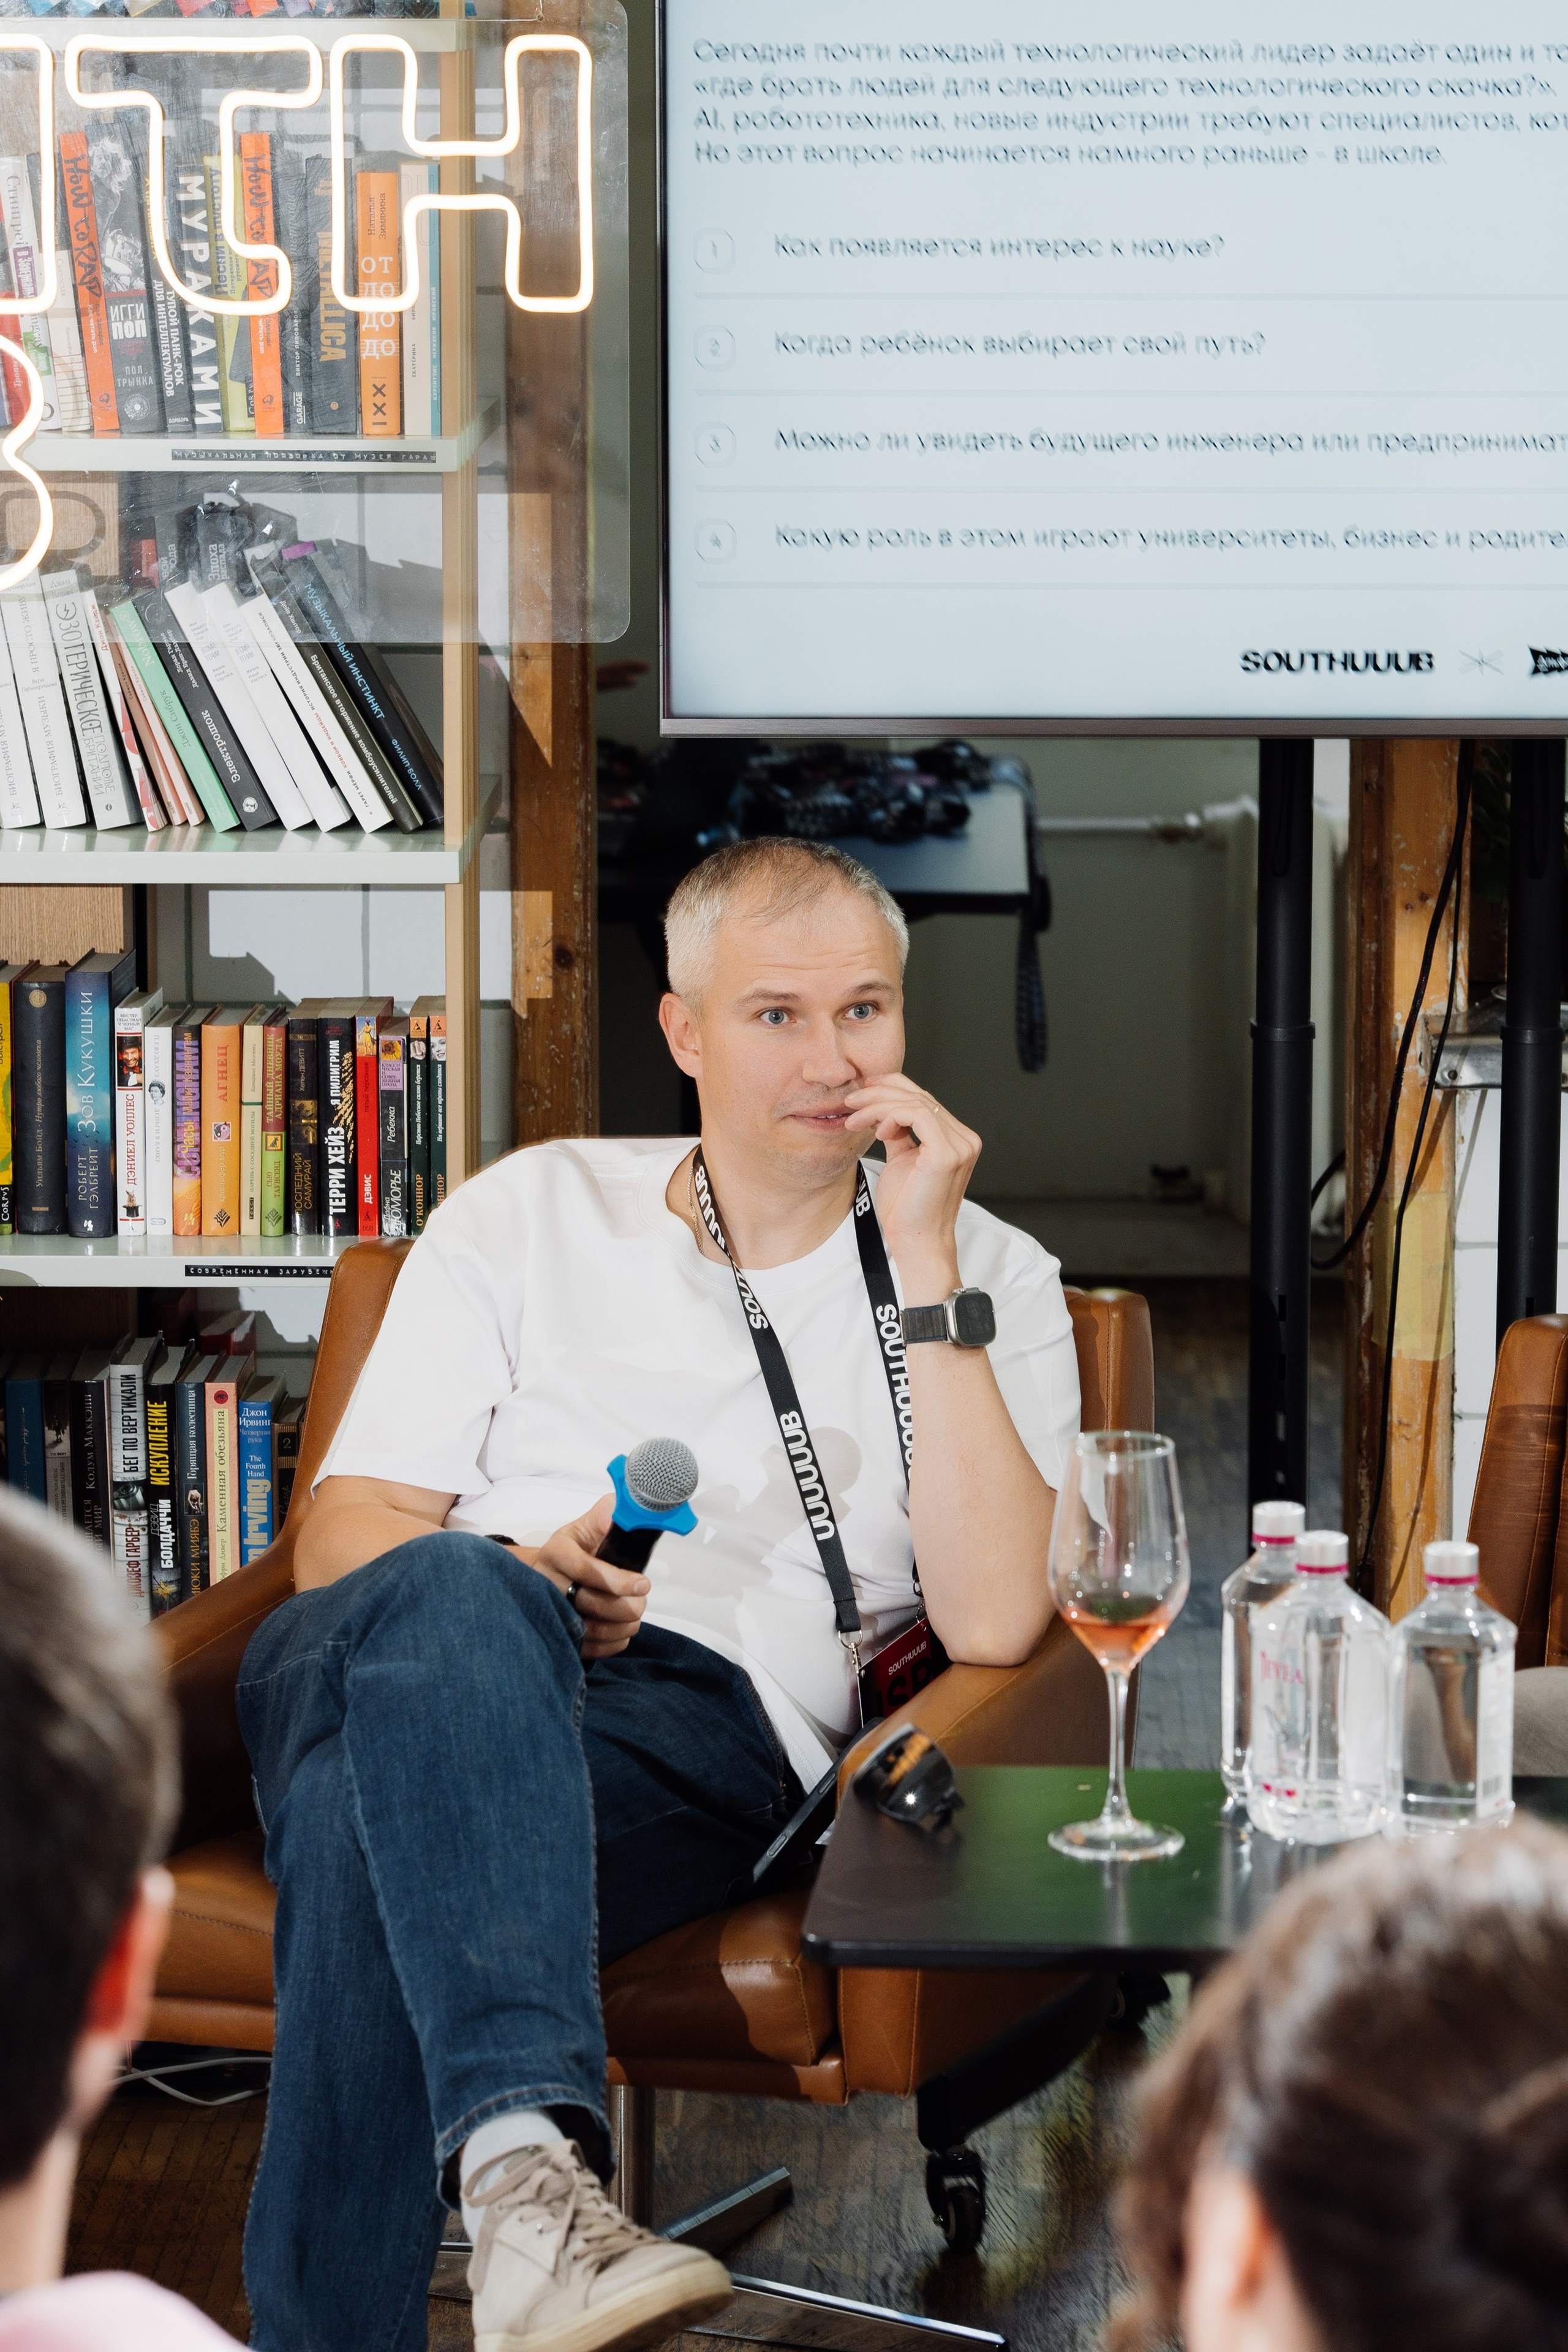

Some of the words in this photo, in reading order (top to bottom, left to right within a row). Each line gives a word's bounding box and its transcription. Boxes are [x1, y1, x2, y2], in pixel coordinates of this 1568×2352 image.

[693, 38, 806, 65] Сегодня
[815, 42, 891, 63] почти
[899, 39, 1006, 65] каждый
[1011, 39, 1244, 64] технологический
[1251, 43, 1336, 66] лидер
[1342, 40, 1441, 65] задаёт
[1446, 43, 1512, 65] один
[1520, 44, 1535, 64] и
[693, 76, 755, 100] «где
[760, 70, 842, 99] брать
[848, 72, 935, 98] людей
[941, 77, 991, 100] для
[997, 77, 1169, 100] следующего
[1174, 77, 1422, 98] технологического
[1427, 72, 1558, 98] скачка?»
[733, 105, 946, 135] робототехника,
[953, 110, 1039, 132] новые
[1046, 110, 1189, 135] индустрии
[1199, 107, 1315, 135] требуют
[1320, 110, 1521, 135] специалистов,
[695, 140, 731, 164] Но
[736, 143, 797, 164] этот
[803, 143, 904, 169] вопрос
[910, 144, 1071, 165] начинается
[1078, 144, 1196, 165] намного
[1202, 144, 1309, 170] раньше
[1334, 145, 1349, 164] в
[1356, 145, 1447, 165] школе.
[361, 256, 393, 274] ОТ
[774, 233, 823, 258] Как
[829, 238, 982, 258] появляется
[990, 238, 1103, 262] интерес
[1110, 238, 1125, 257] к
[1131, 233, 1225, 263] науке?
[153, 279, 165, 303] ДЛЯ
[166, 290, 179, 325] ТУПОЙ
[177, 175, 222, 424] МУРАКАМИ
[110, 303, 145, 322] ИГГИ
[362, 311, 396, 331] ДО
[111, 320, 148, 340] ПОП
[775, 331, 852, 358] Когда
[860, 330, 976, 359] ребёнок
[982, 330, 1118, 360] выбирает
[1122, 332, 1187, 355] свой
[1195, 331, 1266, 360] путь?
[157, 303, 175, 397] ИНТЕЛЛЕКТУАЛОВ
[170, 326, 184, 386] ПАНК-РОК
[363, 339, 396, 360] ДО
[116, 375, 154, 388] ТРЫНКА
[126, 366, 143, 375] ПОЛ
[295, 391, 304, 425] GARAGE
[175, 450, 257, 460] МУЗЫКАЛЬНАЯ
[354, 452, 392, 461] МУЗЕЯ
[774, 428, 871, 451] Можно
[876, 432, 909, 451] ли
[916, 432, 1023, 456] увидеть
[1028, 427, 1160, 456] будущего
[1166, 432, 1305, 457] инженера
[1312, 433, 1359, 452] или
[775, 524, 861, 552] Какую
[867, 528, 932, 552] роль
[938, 528, 953, 548] в
[959, 528, 1027, 548] этом
[1034, 529, 1132, 553] играют
[1138, 529, 1336, 553] университеты,
[1342, 524, 1439, 549] бизнес
[1445, 530, 1461, 548] и
[304, 582, 355, 663] МУЗЫКАЛЬНЫЙ
[348, 662, 385, 720] ИНСТИНКТ
[1238, 648, 1436, 676] SOUTHUUUB
[159, 689, 178, 723] Сибрук
[176, 723, 192, 748] Джон
[201, 709, 241, 784] Электрошок
[311, 654, 337, 699] Британское
[334, 698, 361, 739] вторжение
[357, 739, 398, 805] комбоусилителей
[83, 737, 105, 796] БРИТАНИИ
[391, 738, 411, 768] ФИЛИП
[407, 767, 423, 791] БОЛЛ
[217, 1044, 230, 1102] АГНЕЦ
[266, 1033, 275, 1080] ДНЕВНИК
[329, 1040, 341, 1098] ПИЛИГРИМ
[126, 1093, 135, 1137] УОЛЛЕС
[330, 1098, 340, 1106] Я
[181, 1121, 195, 1154] Часы
[387, 1106, 396, 1143] Ребекка
[126, 1139, 137, 1186] ДЭНИЕЛ
[325, 1126, 346, 1165] ХЕЙЗ
[78, 1155, 87, 1201] РОБЕРТ
[89, 1147, 99, 1209] ГЭЛБРЕЙТ
[304, 1159, 312, 1210] САМУРАЙ
[329, 1167, 347, 1216] ТЕРРИ
[364, 1174, 374, 1204] ДЭВИС
[120, 1374, 138, 1434] ВЕРТИКАЛИ
[188, 1389, 197, 1438] колесница
[241, 1408, 267, 1417] Джон
[216, 1410, 226, 1466] обезьяна
[239, 1417, 272, 1428] Ирвинг
[122, 1437, 138, 1451] ПО
[147, 1400, 170, 1486] ИСКУПЛЕНИЕ
[187, 1439, 200, 1480] Горящая
[123, 1455, 139, 1473] БЕГ
[216, 1470, 227, 1533] Каменная
[243, 1479, 271, 1545] Irving
[149, 1503, 160, 1536] ДЭВИД
[159, 1499, 175, 1569] БОЛДАЧЧИ
[125, 1526, 141, 1558] ГАРБЕР
[189, 1518, 200, 1559] МИЯБЭ
[888, 1640, 927, 1676] SOUTHUUUB
